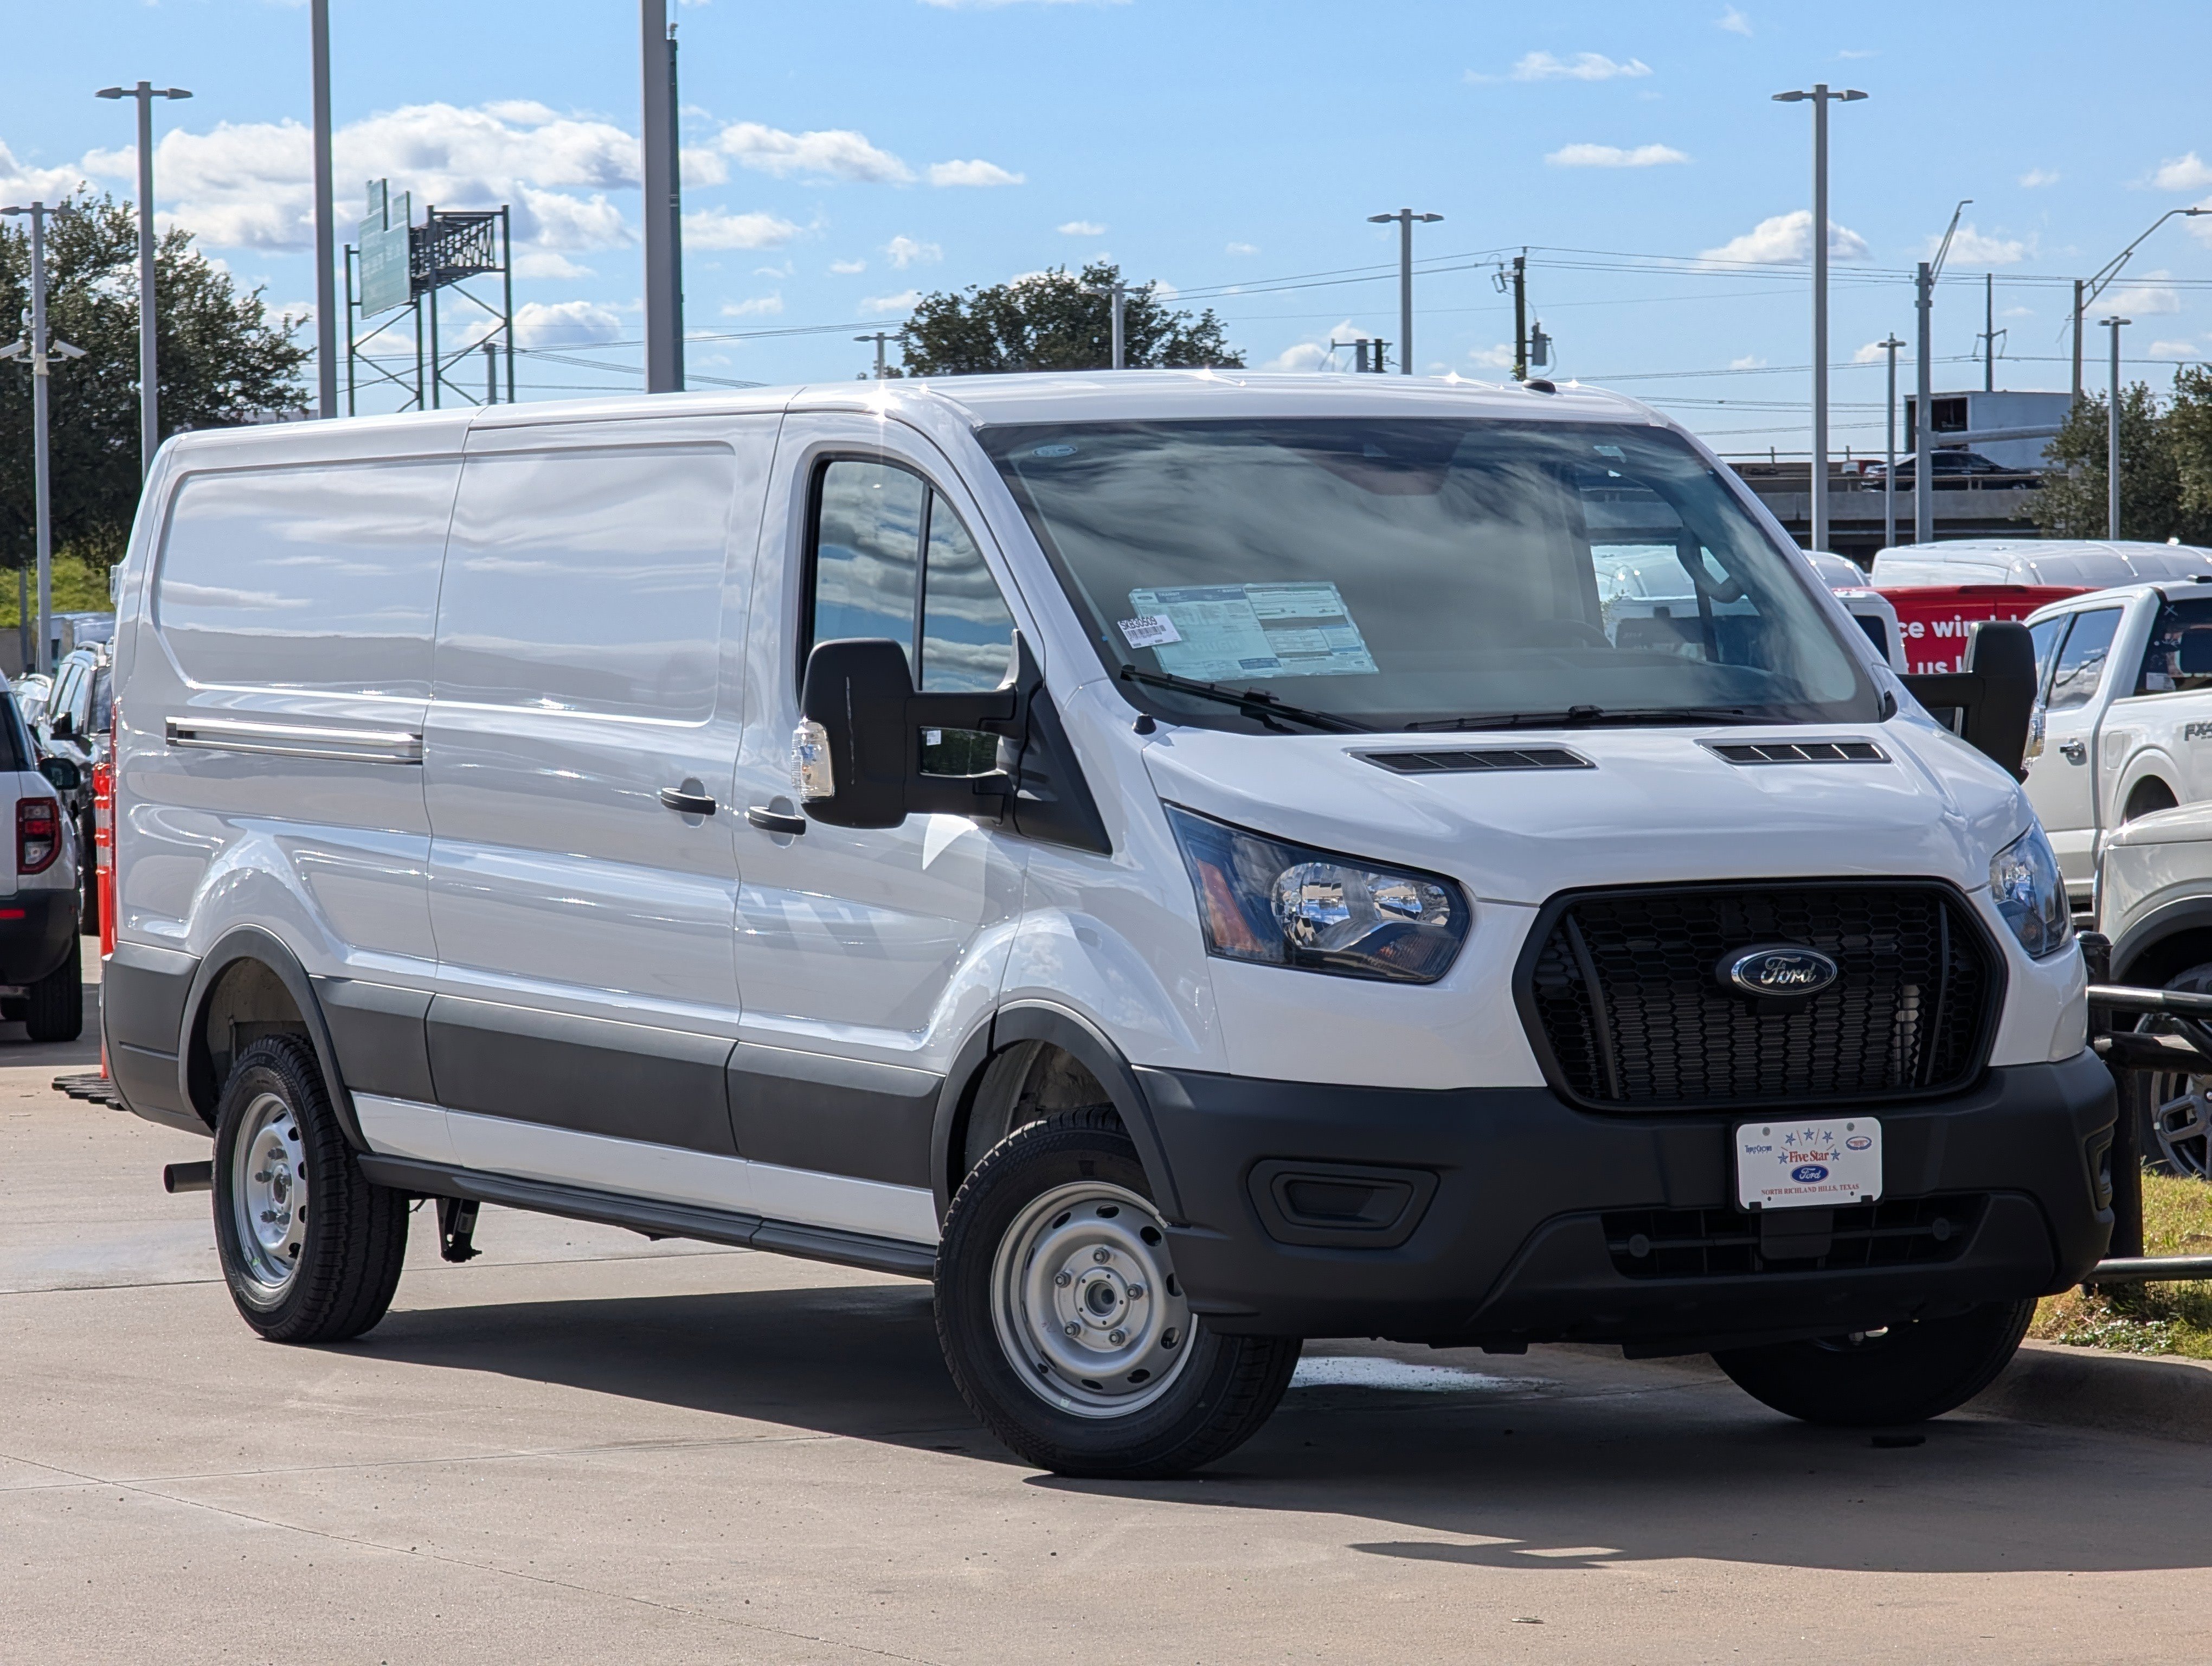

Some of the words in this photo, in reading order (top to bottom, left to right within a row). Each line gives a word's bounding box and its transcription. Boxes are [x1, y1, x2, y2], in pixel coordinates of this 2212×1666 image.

[1898, 621, 1925, 638] ce
[1761, 957, 1817, 984] Ford
[1789, 1151, 1809, 1163] Five
[1810, 1150, 1829, 1161] Star
[1799, 1168, 1822, 1180] Ford
